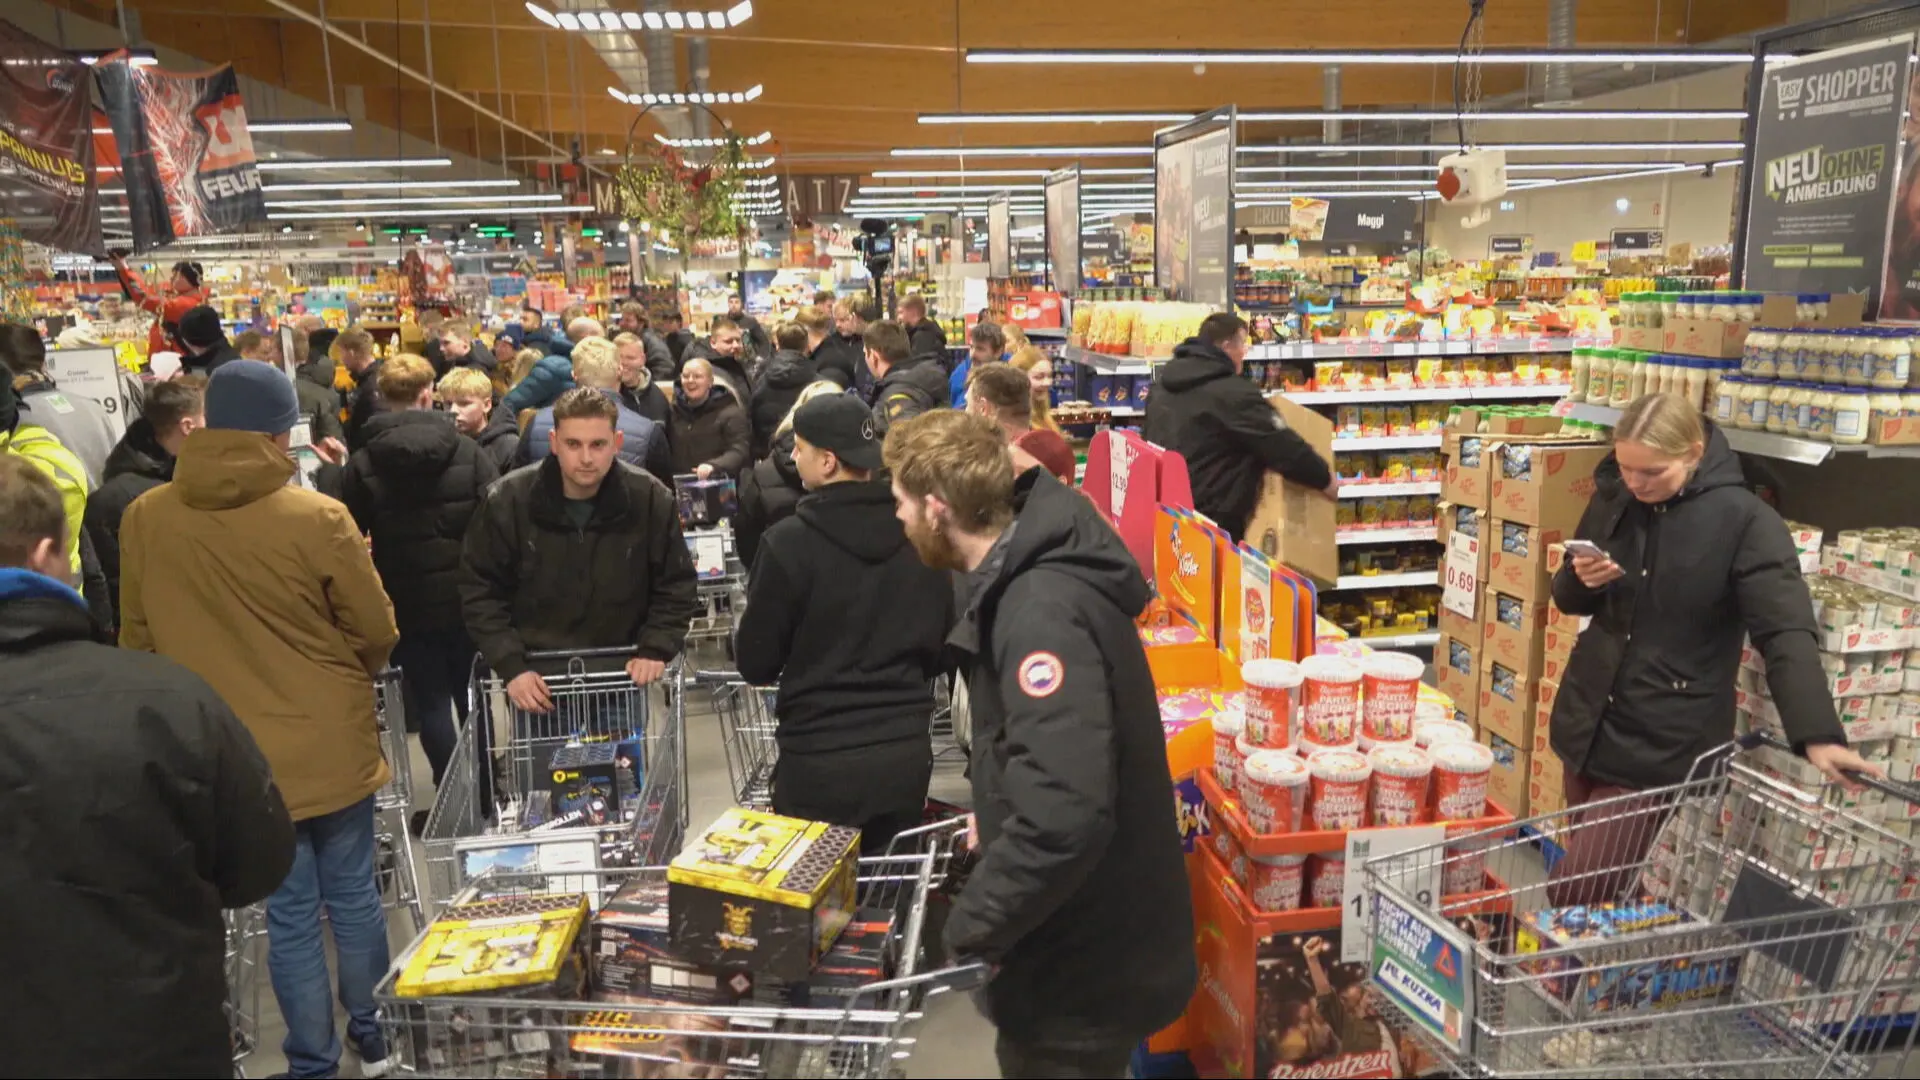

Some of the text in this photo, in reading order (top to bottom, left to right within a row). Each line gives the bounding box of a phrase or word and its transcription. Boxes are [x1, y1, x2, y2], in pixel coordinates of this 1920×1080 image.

[1804, 60, 1898, 106] SHOPPER
[1768, 146, 1883, 192] NEU OHNE
[1784, 172, 1877, 205] ANMELDUNG
[1356, 212, 1385, 229] Maggi
[1448, 566, 1474, 593] 0.69
[1270, 1051, 1394, 1080] Berentzen
